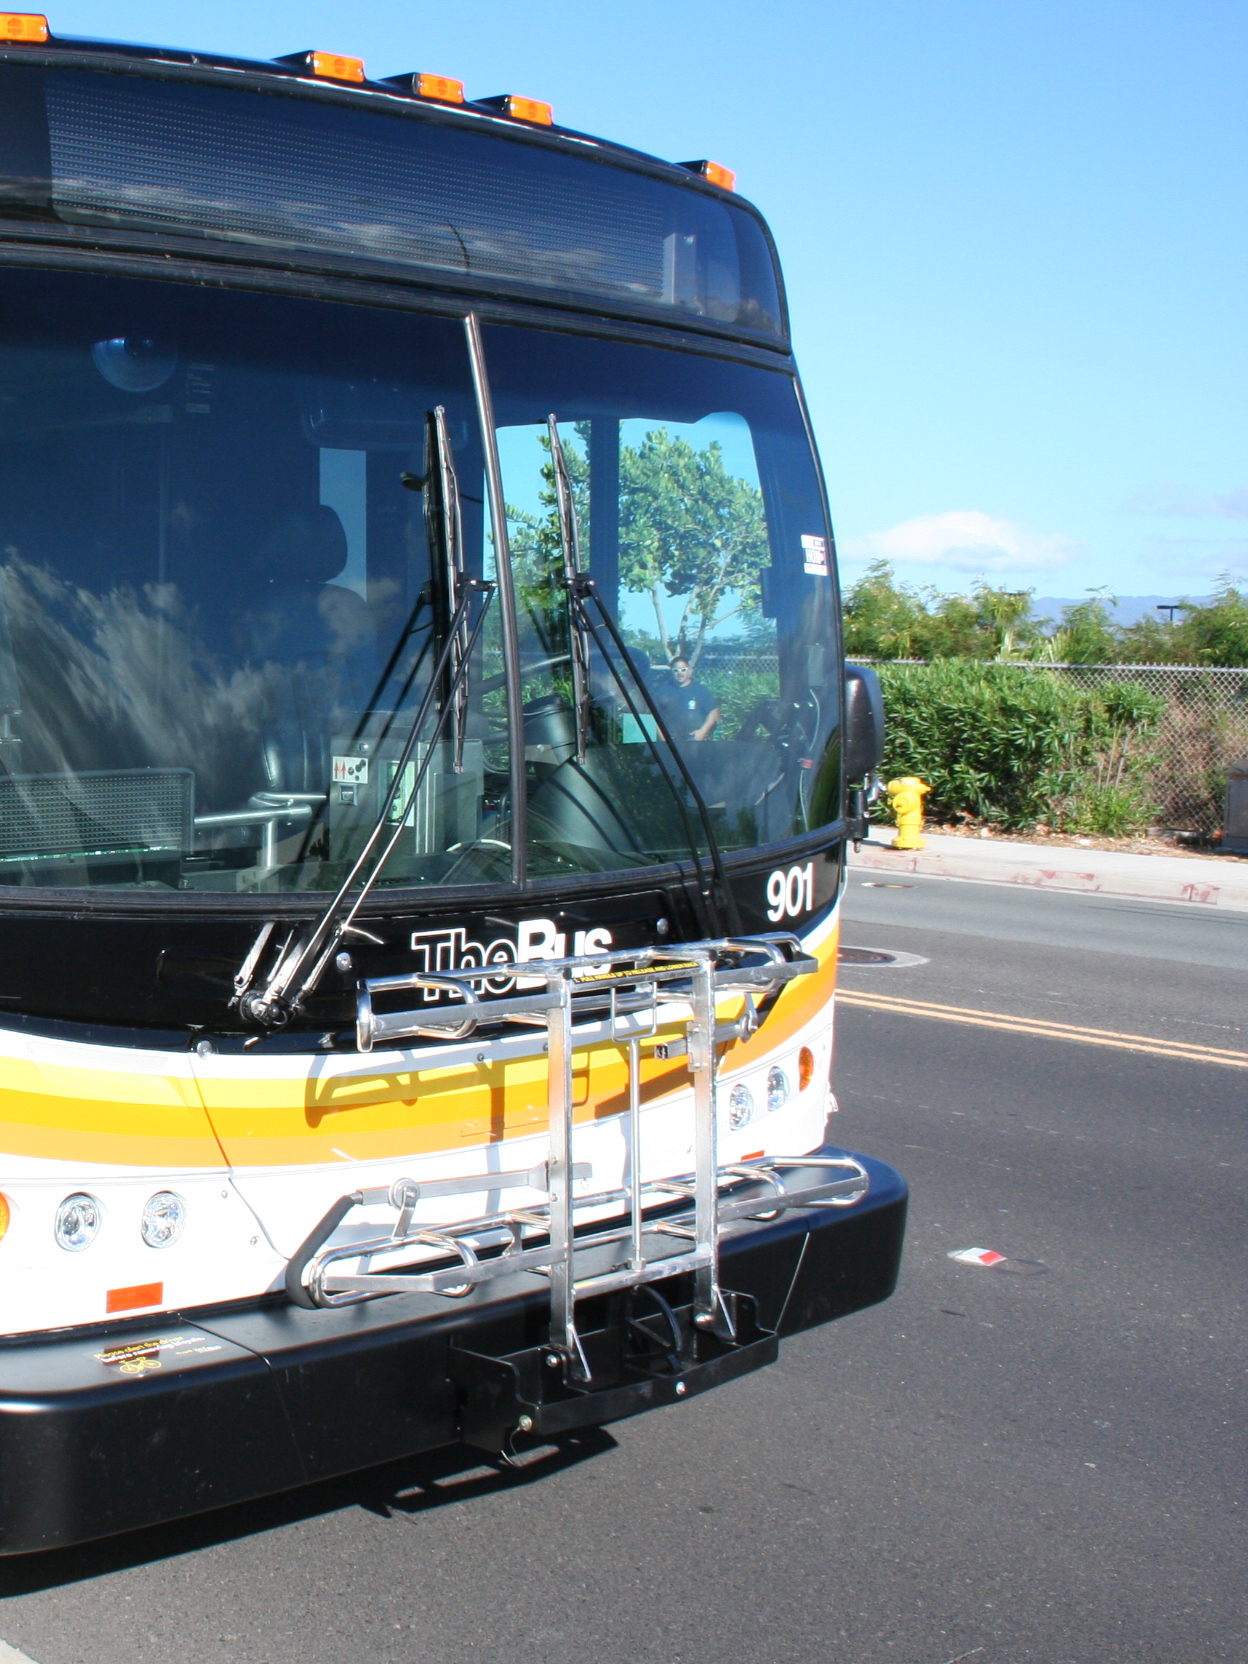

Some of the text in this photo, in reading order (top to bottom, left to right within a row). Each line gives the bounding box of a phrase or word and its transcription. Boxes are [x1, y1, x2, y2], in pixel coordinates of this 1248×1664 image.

[766, 861, 814, 922] 901
[411, 918, 613, 1002] TheBus
[93, 1348, 125, 1360] Please
